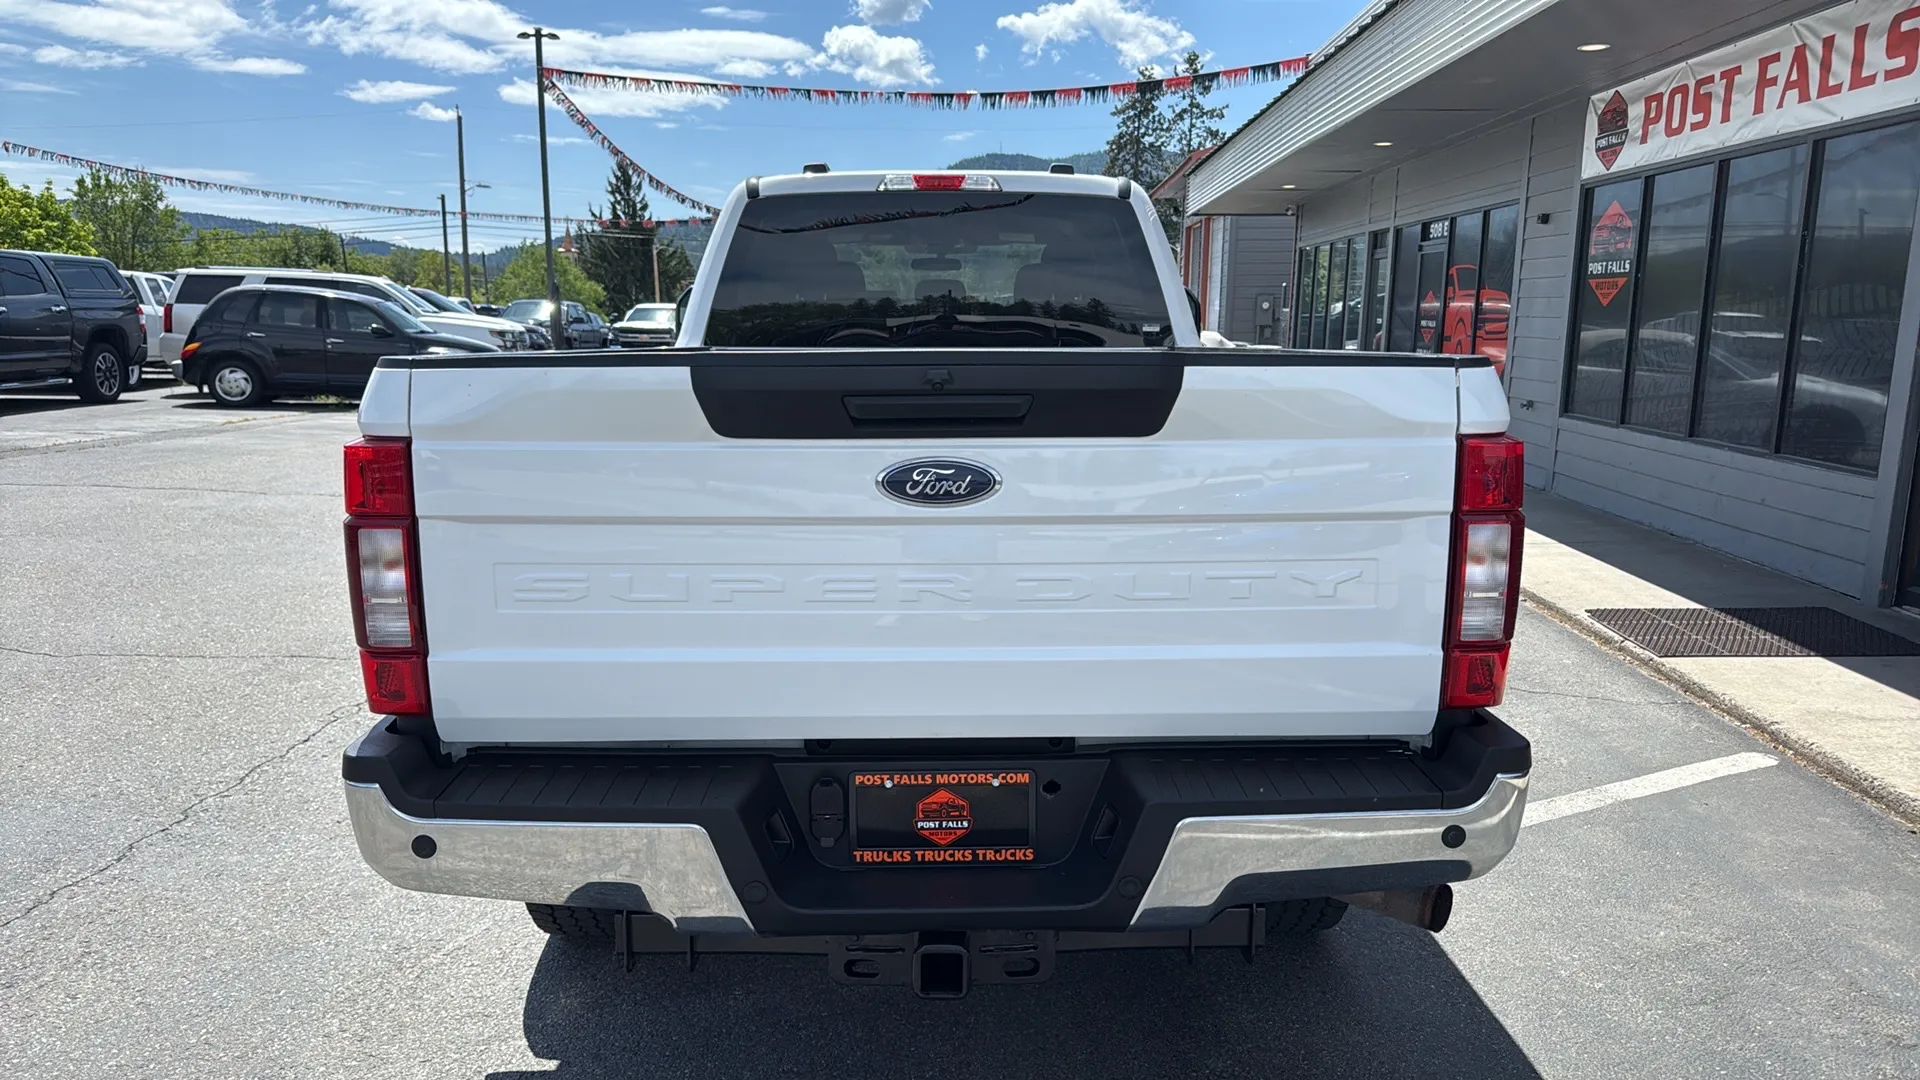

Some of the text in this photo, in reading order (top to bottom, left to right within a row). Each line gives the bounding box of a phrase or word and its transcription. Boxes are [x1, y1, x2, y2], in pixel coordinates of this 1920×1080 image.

[1640, 6, 1920, 146] POST FALLS
[1588, 259, 1631, 275] POST FALLS
[905, 467, 972, 496] Ford
[513, 569, 1364, 604] SUPER DUTY
[855, 774, 890, 786] POST
[893, 773, 932, 785] FALLS
[917, 820, 969, 829] POST FALLS
[853, 850, 911, 862] TRUCKS
[915, 850, 973, 862] TRUCKS
